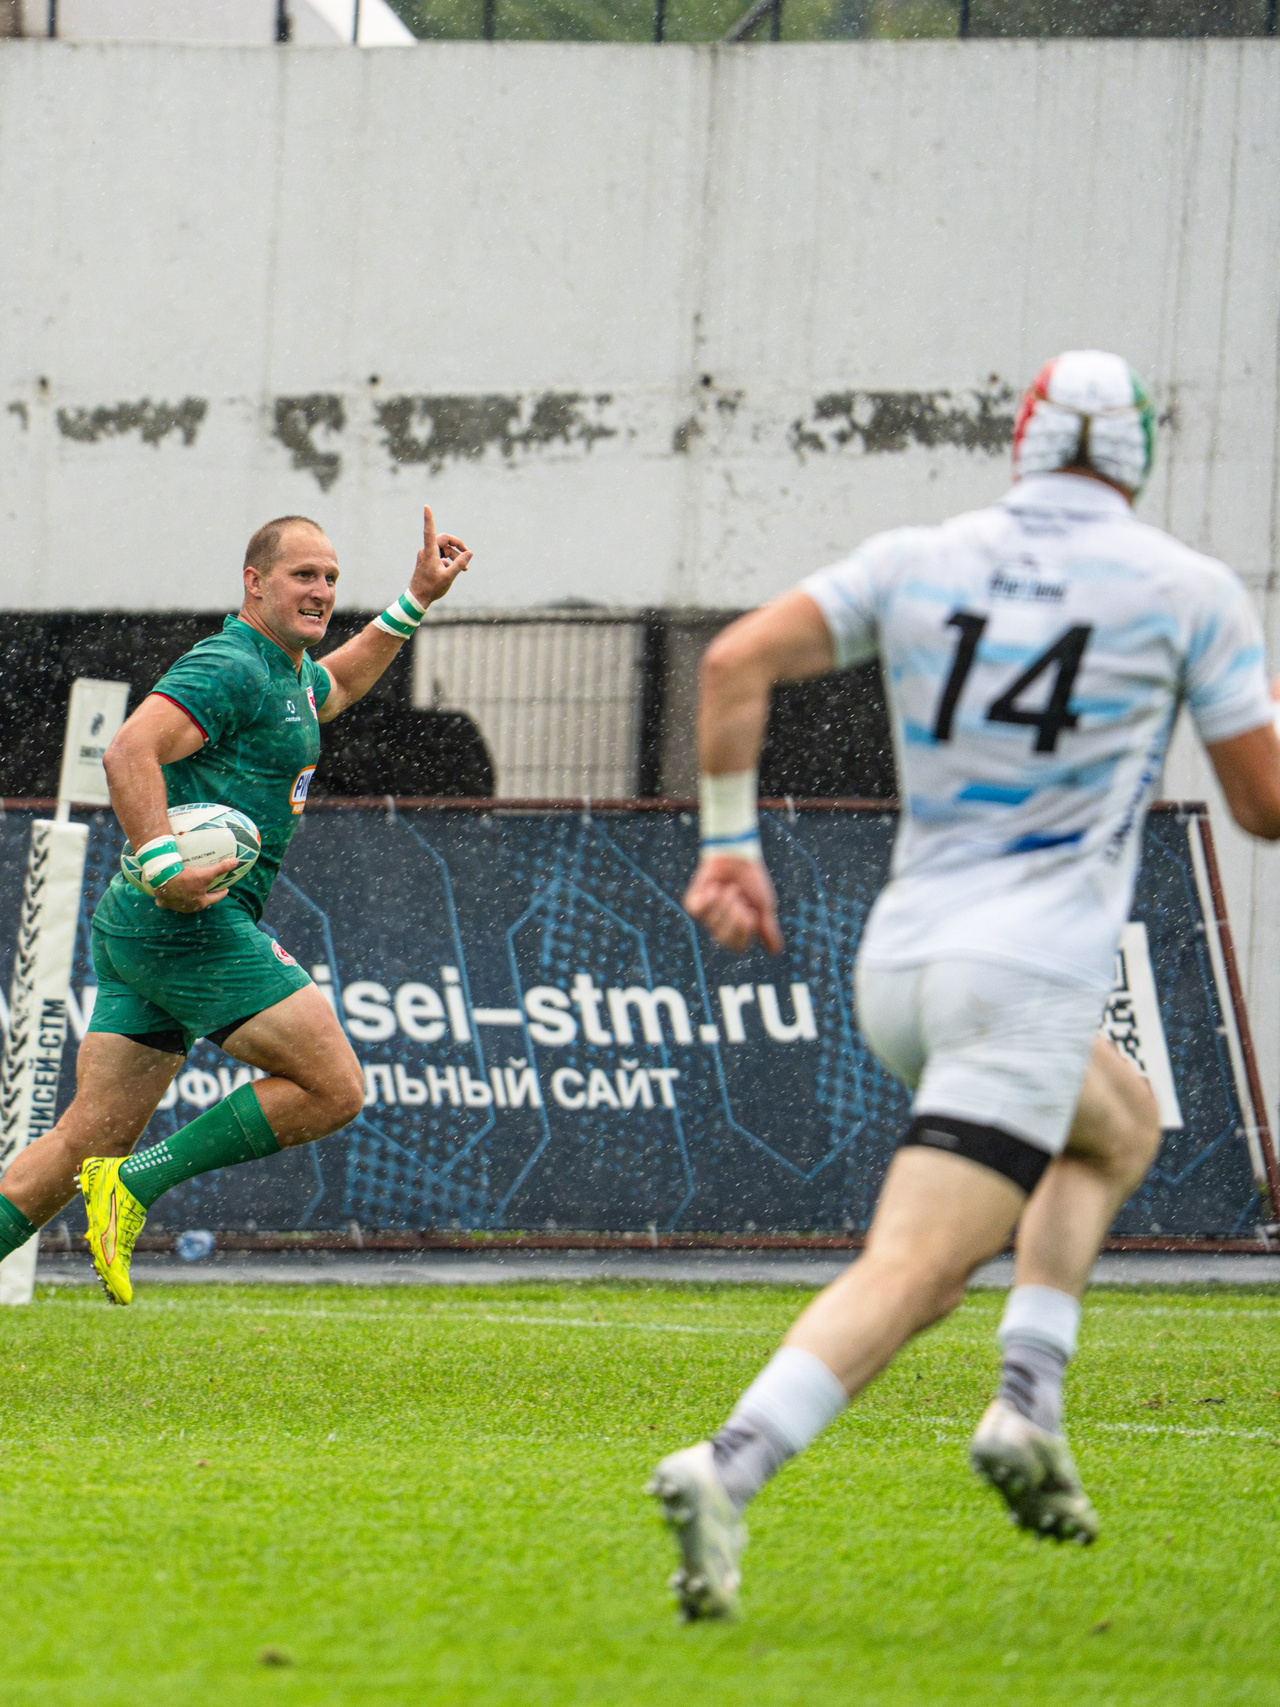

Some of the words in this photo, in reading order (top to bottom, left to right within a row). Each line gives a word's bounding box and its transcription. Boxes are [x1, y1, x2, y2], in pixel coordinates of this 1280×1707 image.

[934, 609, 1095, 753] 14
[26, 998, 67, 1143] НИСЕЙ-СТМ
[550, 1057, 681, 1110] САЙТ
